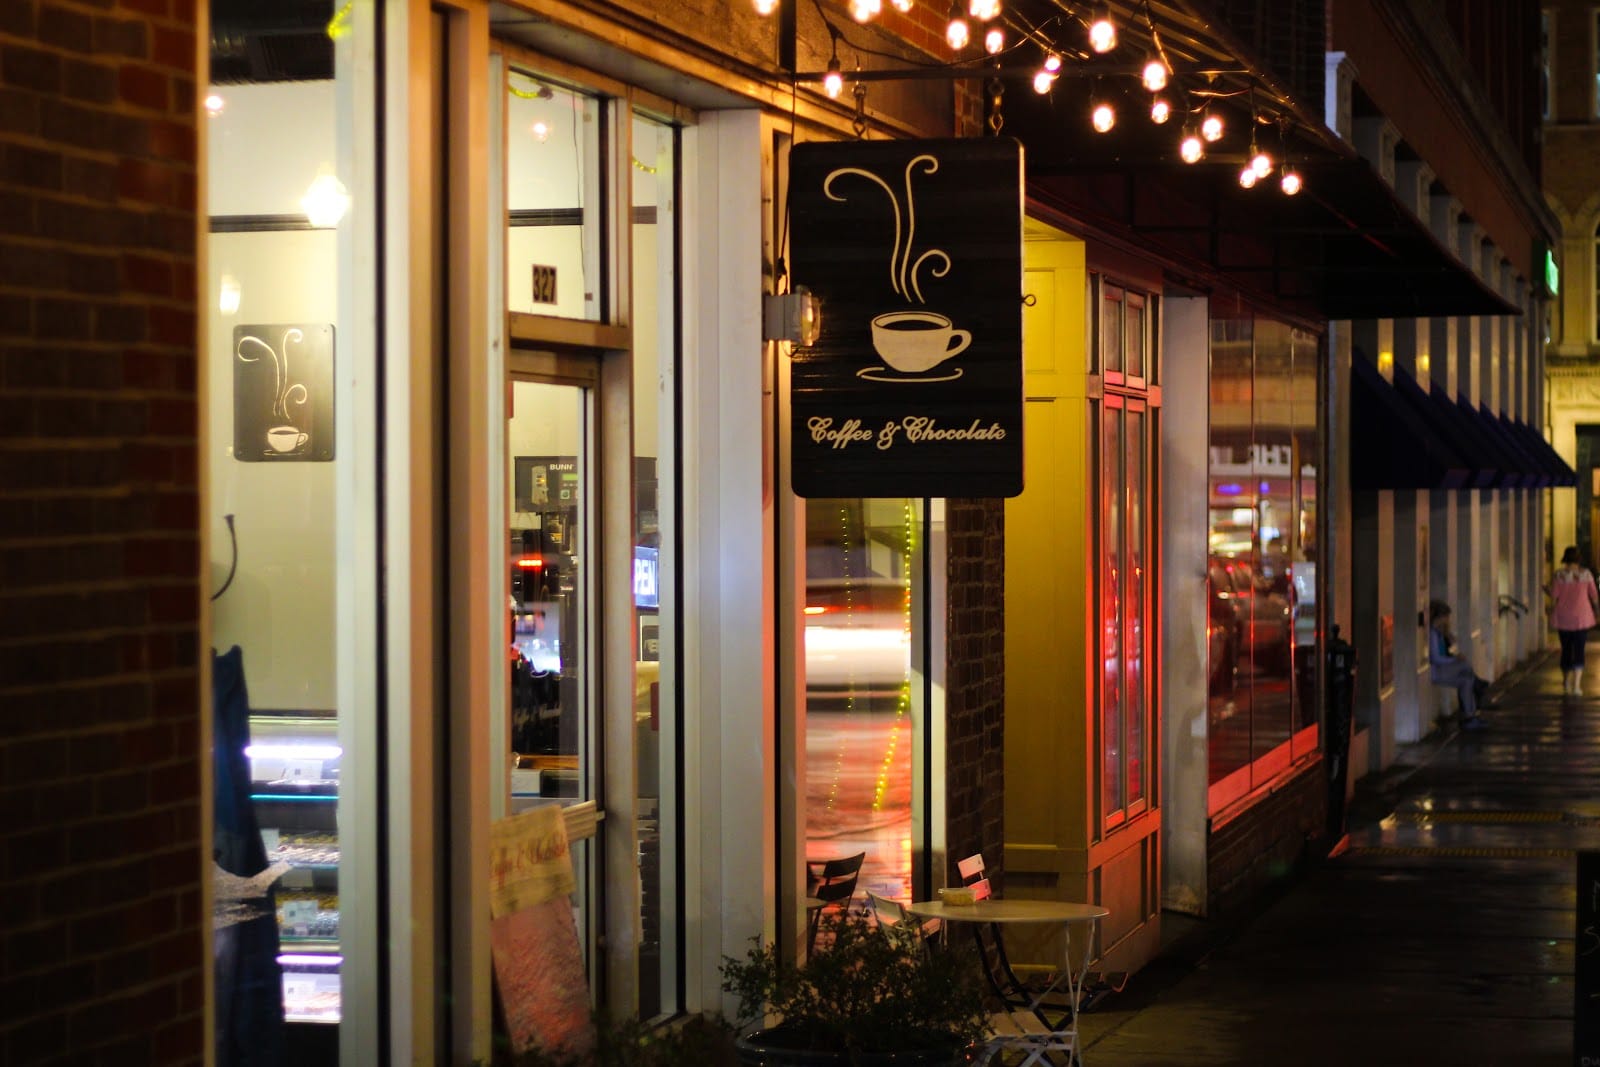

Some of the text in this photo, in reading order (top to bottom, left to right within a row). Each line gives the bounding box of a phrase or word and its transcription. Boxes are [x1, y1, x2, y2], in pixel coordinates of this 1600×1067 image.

[532, 266, 556, 303] 327
[807, 415, 1007, 450] Coffee & Chocolate
[549, 463, 573, 471] BUNN
[633, 558, 656, 595] PEN
